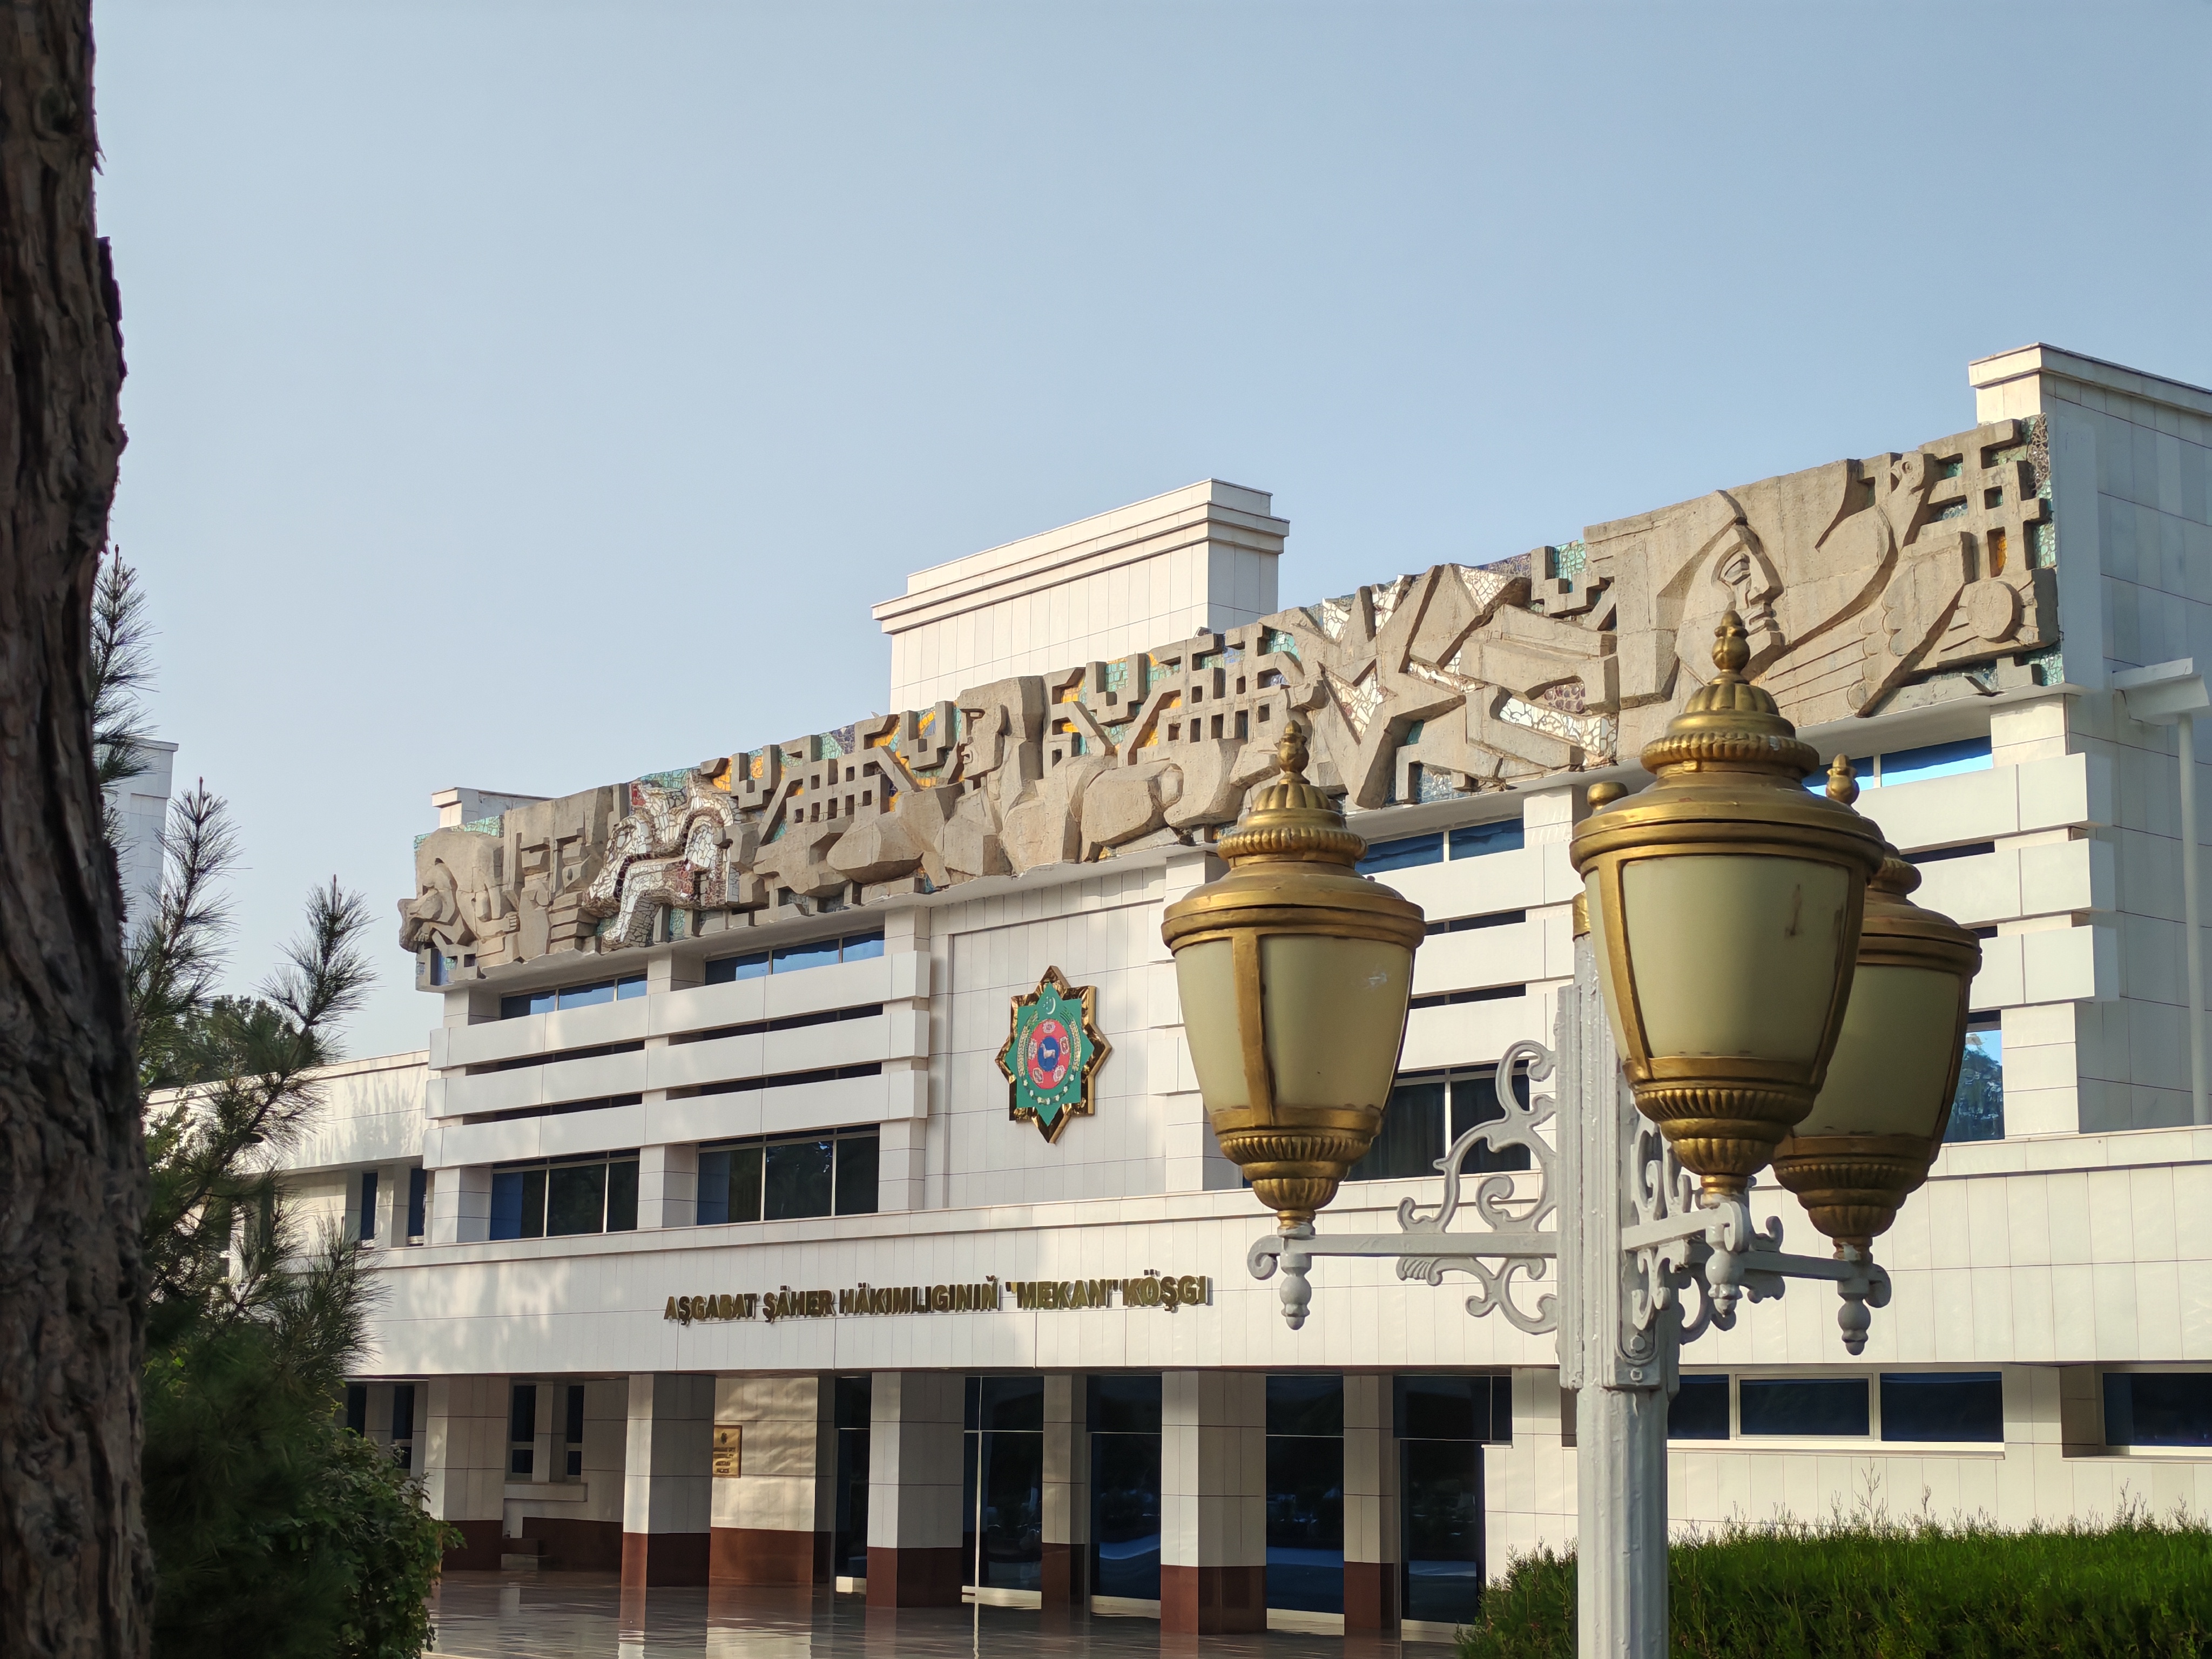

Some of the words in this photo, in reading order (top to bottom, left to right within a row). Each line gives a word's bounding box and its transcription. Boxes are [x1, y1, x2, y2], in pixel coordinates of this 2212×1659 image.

[664, 1293, 757, 1325] AŞGABAT
[762, 1285, 833, 1323] ŞÄHER
[1122, 1269, 1206, 1311] KÖŞGI
